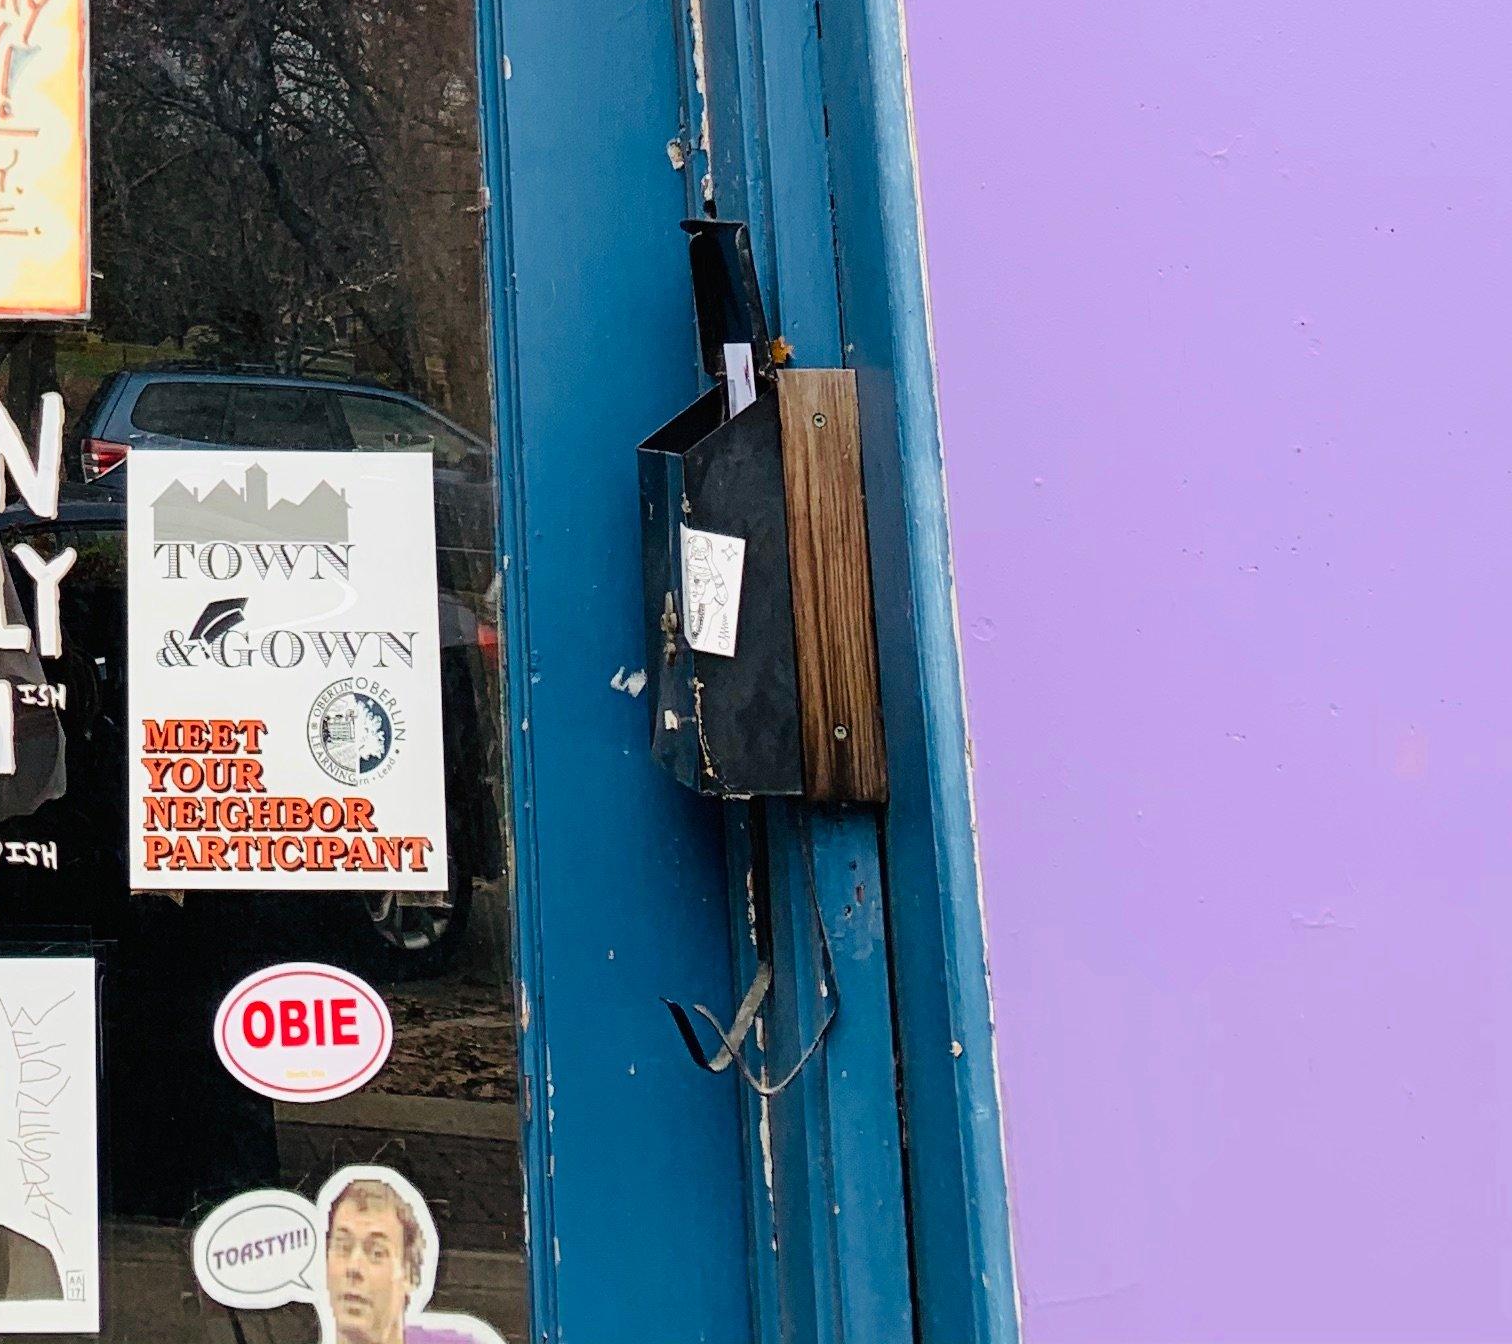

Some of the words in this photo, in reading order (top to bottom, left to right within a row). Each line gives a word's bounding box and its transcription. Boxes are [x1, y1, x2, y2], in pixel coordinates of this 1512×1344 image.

[152, 542, 356, 581] TOWN
[141, 718, 268, 754] MEET
[141, 757, 267, 793] YOUR
[142, 796, 378, 832] NEIGHBOR
[143, 836, 434, 872] PARTICIPANT
[241, 998, 360, 1050] OBIE
[212, 1228, 309, 1270] TOASTY!!!
